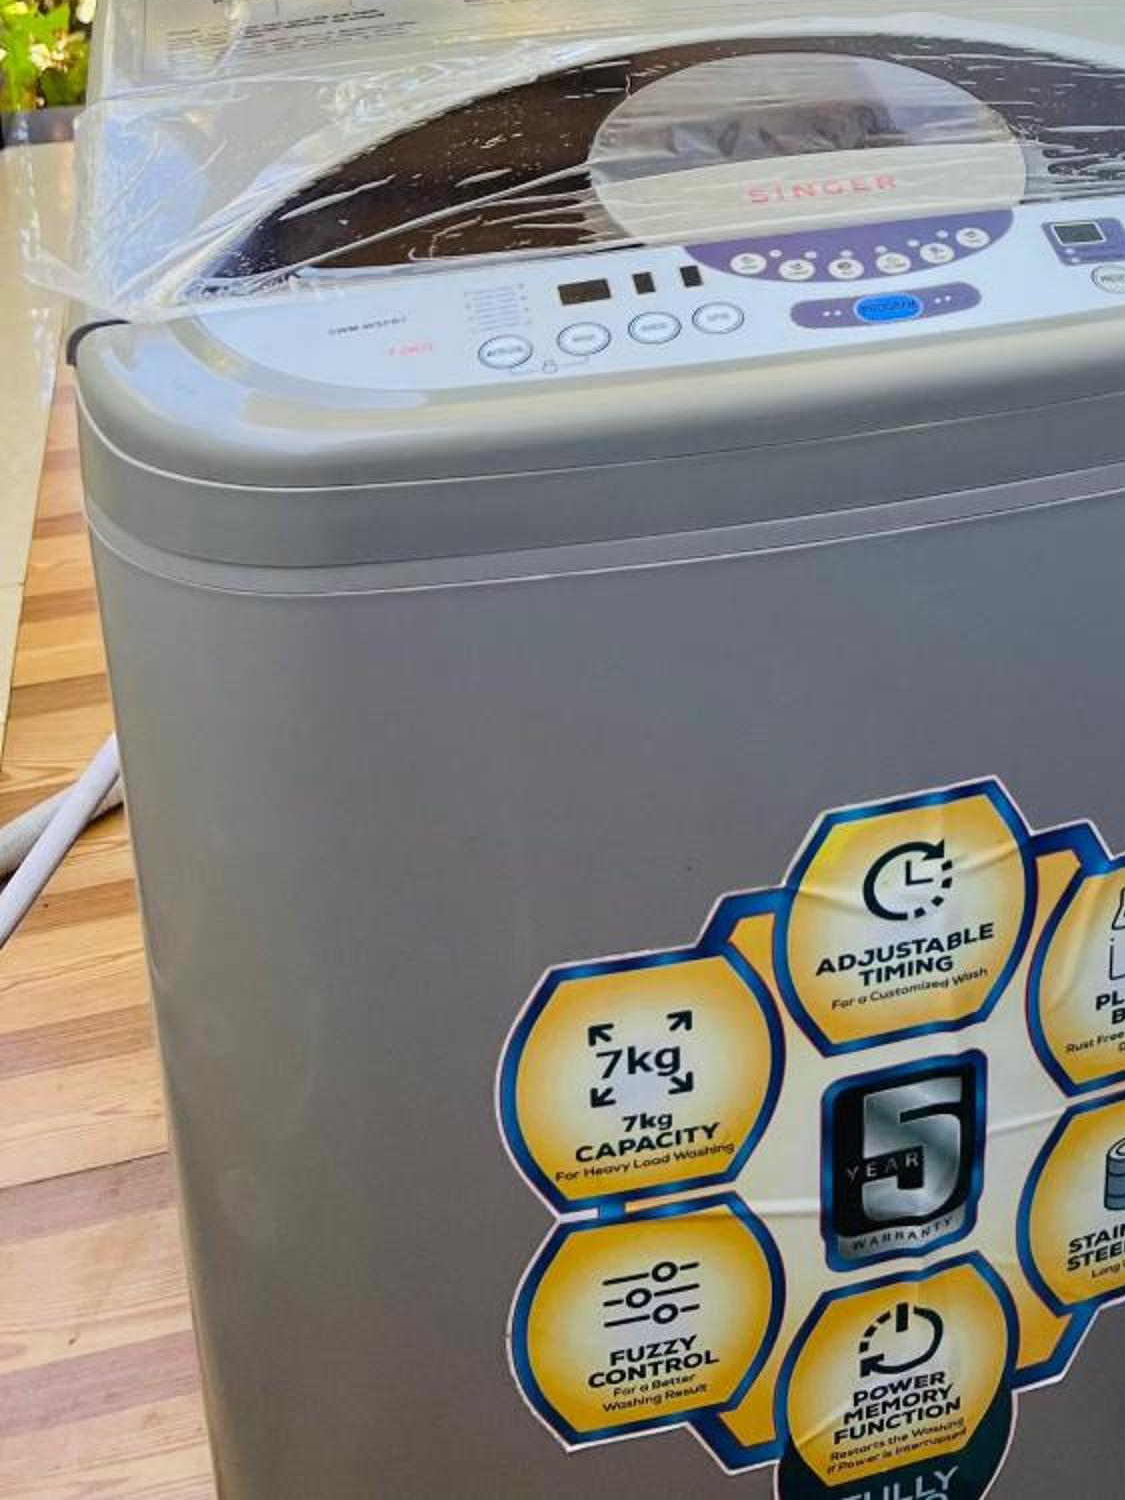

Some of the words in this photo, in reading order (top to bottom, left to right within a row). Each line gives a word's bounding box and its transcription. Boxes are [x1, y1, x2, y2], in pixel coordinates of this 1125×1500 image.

[748, 173, 897, 203] SINGER
[815, 922, 995, 976] ADJUSTABLE
[831, 997, 854, 1010] For
[858, 995, 867, 1005] a
[869, 979, 949, 1001] Customized
[951, 967, 988, 987] Wash
[858, 956, 953, 987] TIMING
[1065, 1039, 1095, 1053] Rust
[1097, 1030, 1125, 1045] Free
[595, 1046, 681, 1080] 7kg
[622, 1112, 673, 1132] 7kg
[575, 1122, 721, 1162] CAPACITY
[861, 1076, 962, 1221] 5
[555, 1170, 578, 1182] For
[583, 1162, 631, 1179] Heavy
[633, 1153, 670, 1169] Load
[673, 1142, 735, 1161] Washing
[846, 1152, 919, 1182] YEAR
[852, 1216, 954, 1251] WARRANTY
[1091, 1262, 1121, 1279] Long
[609, 1334, 698, 1366] FUZZY
[588, 1350, 720, 1388] CONTROL
[613, 1386, 636, 1397] For
[639, 1383, 649, 1391] a
[651, 1373, 696, 1390] Better
[602, 1392, 662, 1412] Washing
[843, 1382, 954, 1425] MEMORY
[853, 1371, 945, 1407] POWER
[833, 1396, 961, 1445] FUNCTION
[831, 1440, 885, 1461] Restarts
[887, 1433, 908, 1445] the
[912, 1418, 965, 1438] Washing
[838, 1455, 880, 1472] Power
[841, 1465, 960, 1500] ULLY
